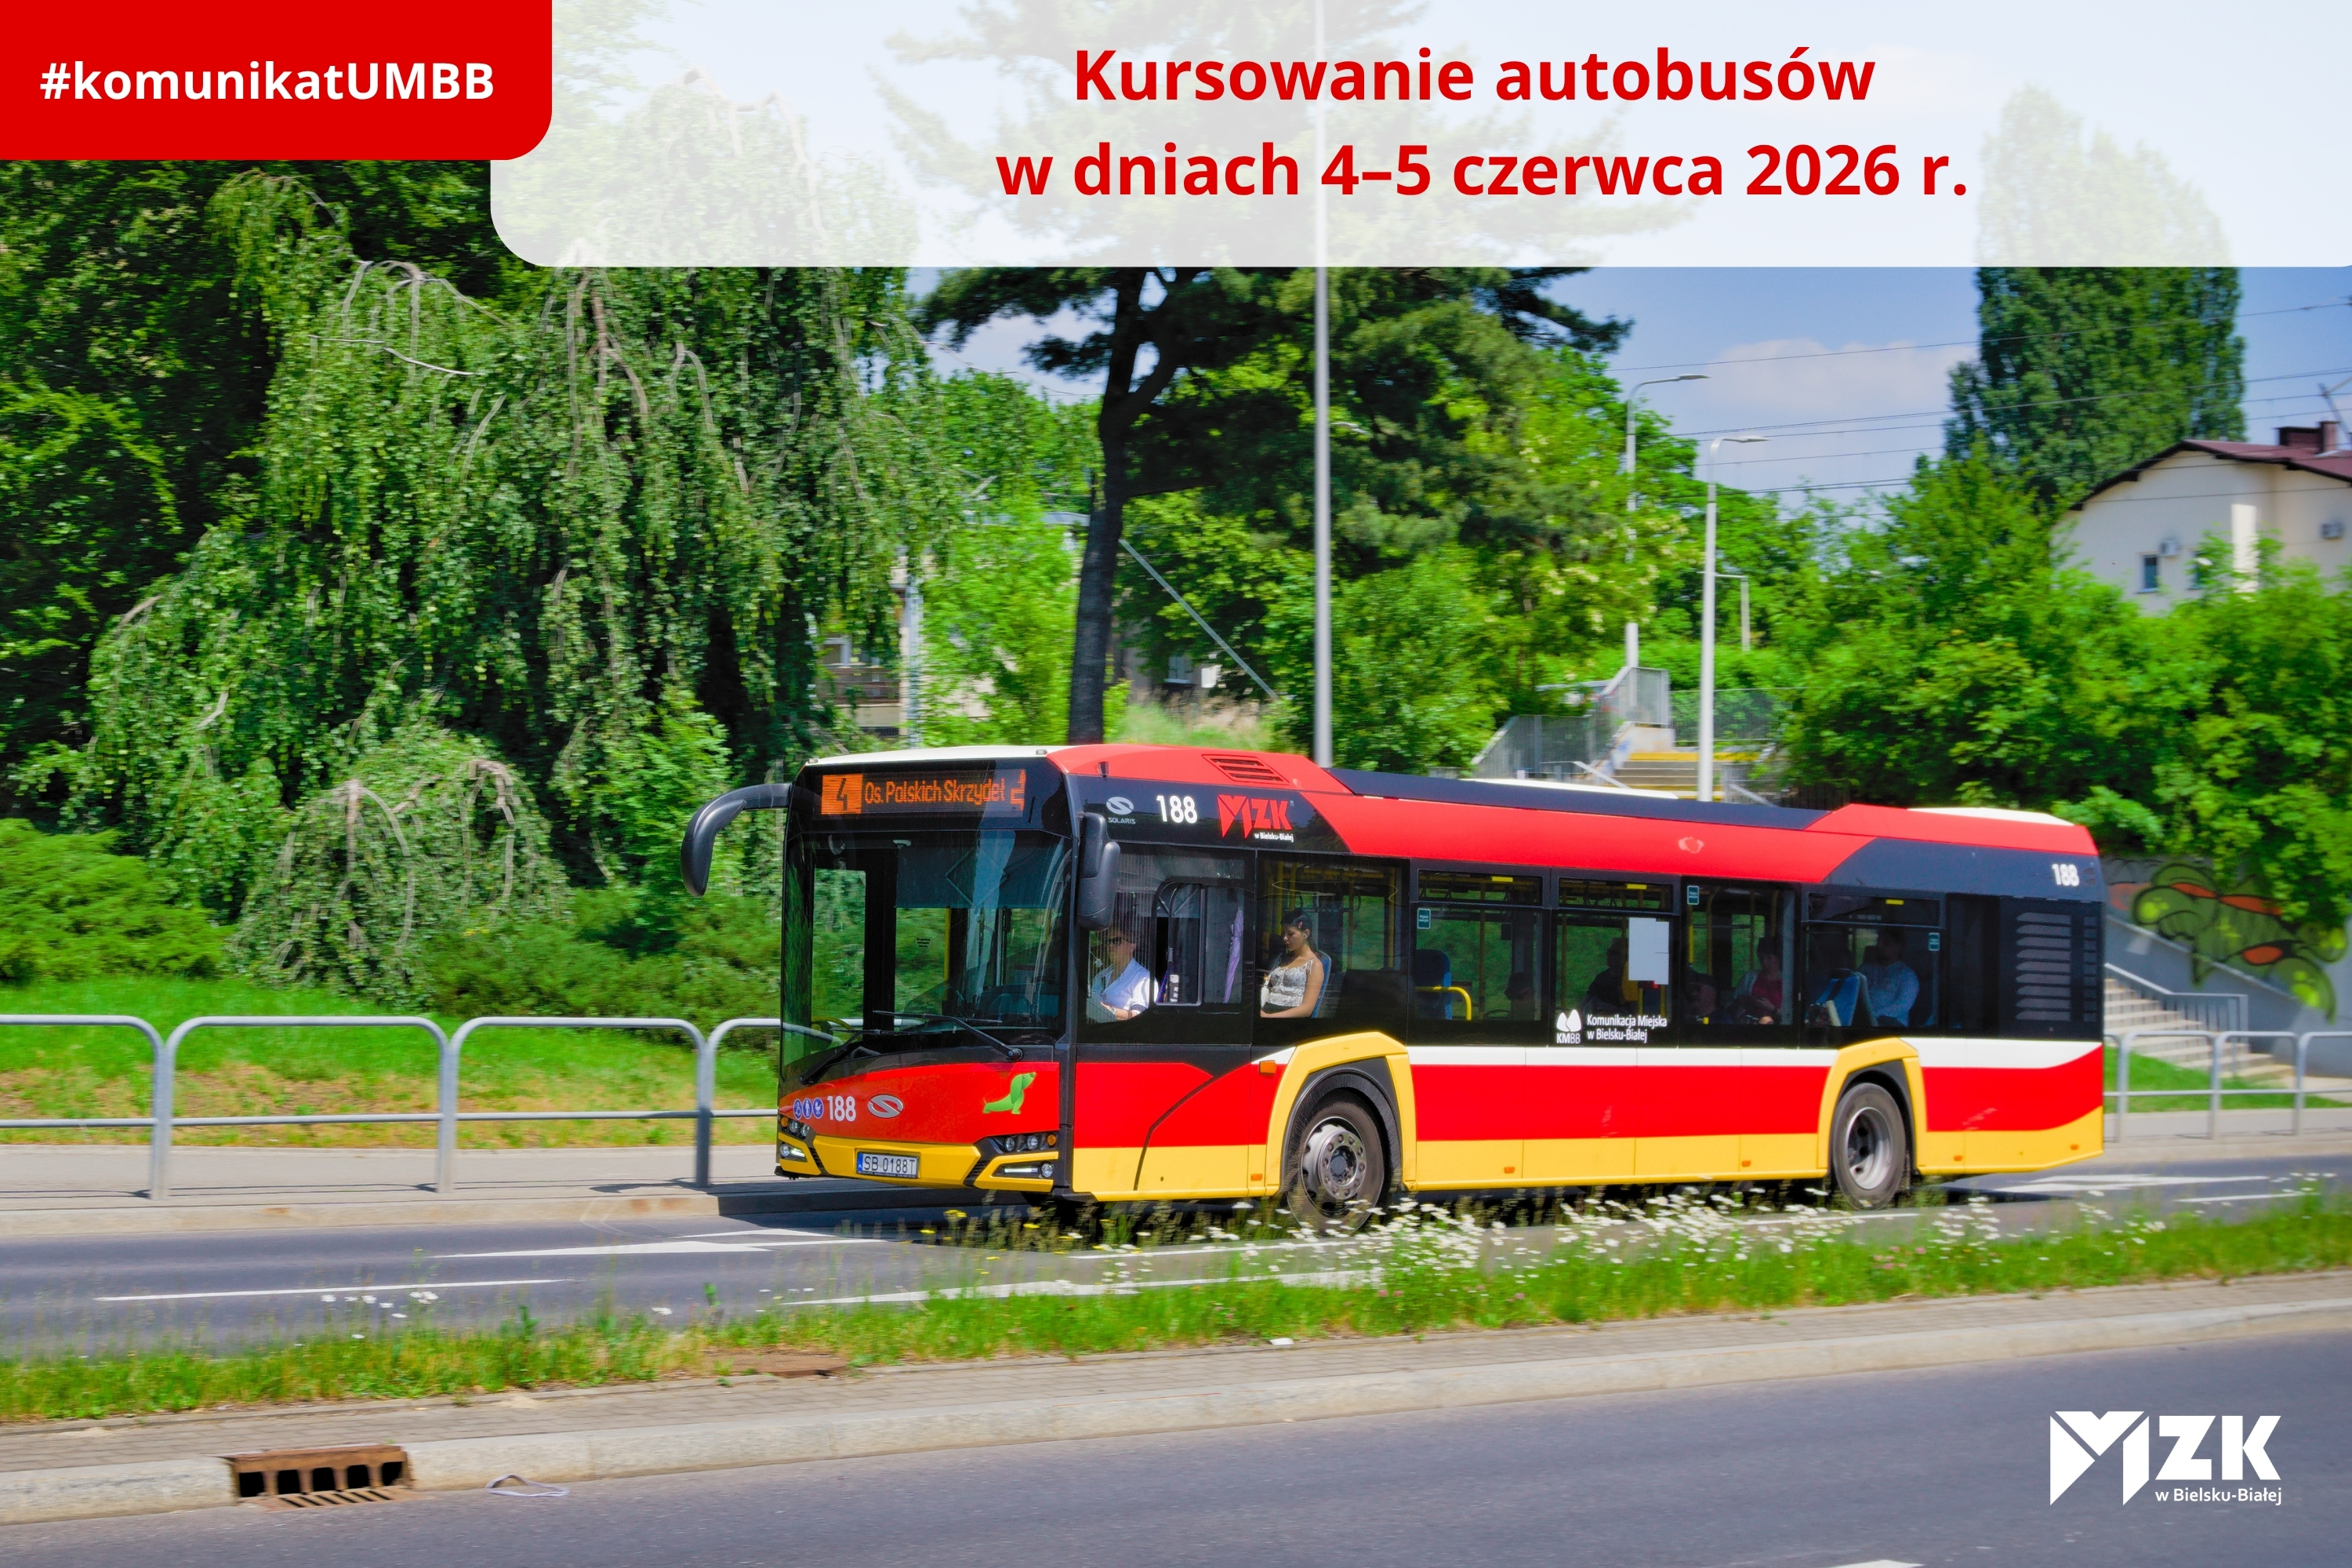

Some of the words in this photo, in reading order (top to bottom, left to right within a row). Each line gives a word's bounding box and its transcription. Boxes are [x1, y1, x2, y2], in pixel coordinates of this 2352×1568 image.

[836, 777, 848, 811] 4
[865, 782, 884, 804] Os.
[886, 779, 942, 804] Polskich
[1156, 794, 1198, 824] 188
[1218, 794, 1292, 838] MZK
[2052, 863, 2080, 887] 188
[1587, 1014, 1636, 1029] Komunikacja
[1638, 1014, 1668, 1029] Miejska
[1556, 1033, 1581, 1044] KMBB
[1587, 1029, 1595, 1040] w
[1596, 1029, 1648, 1044] Bielsku-Białej
[827, 1095, 856, 1122] 188
[864, 1156, 879, 1171] SB
[883, 1157, 915, 1174] 0188T
